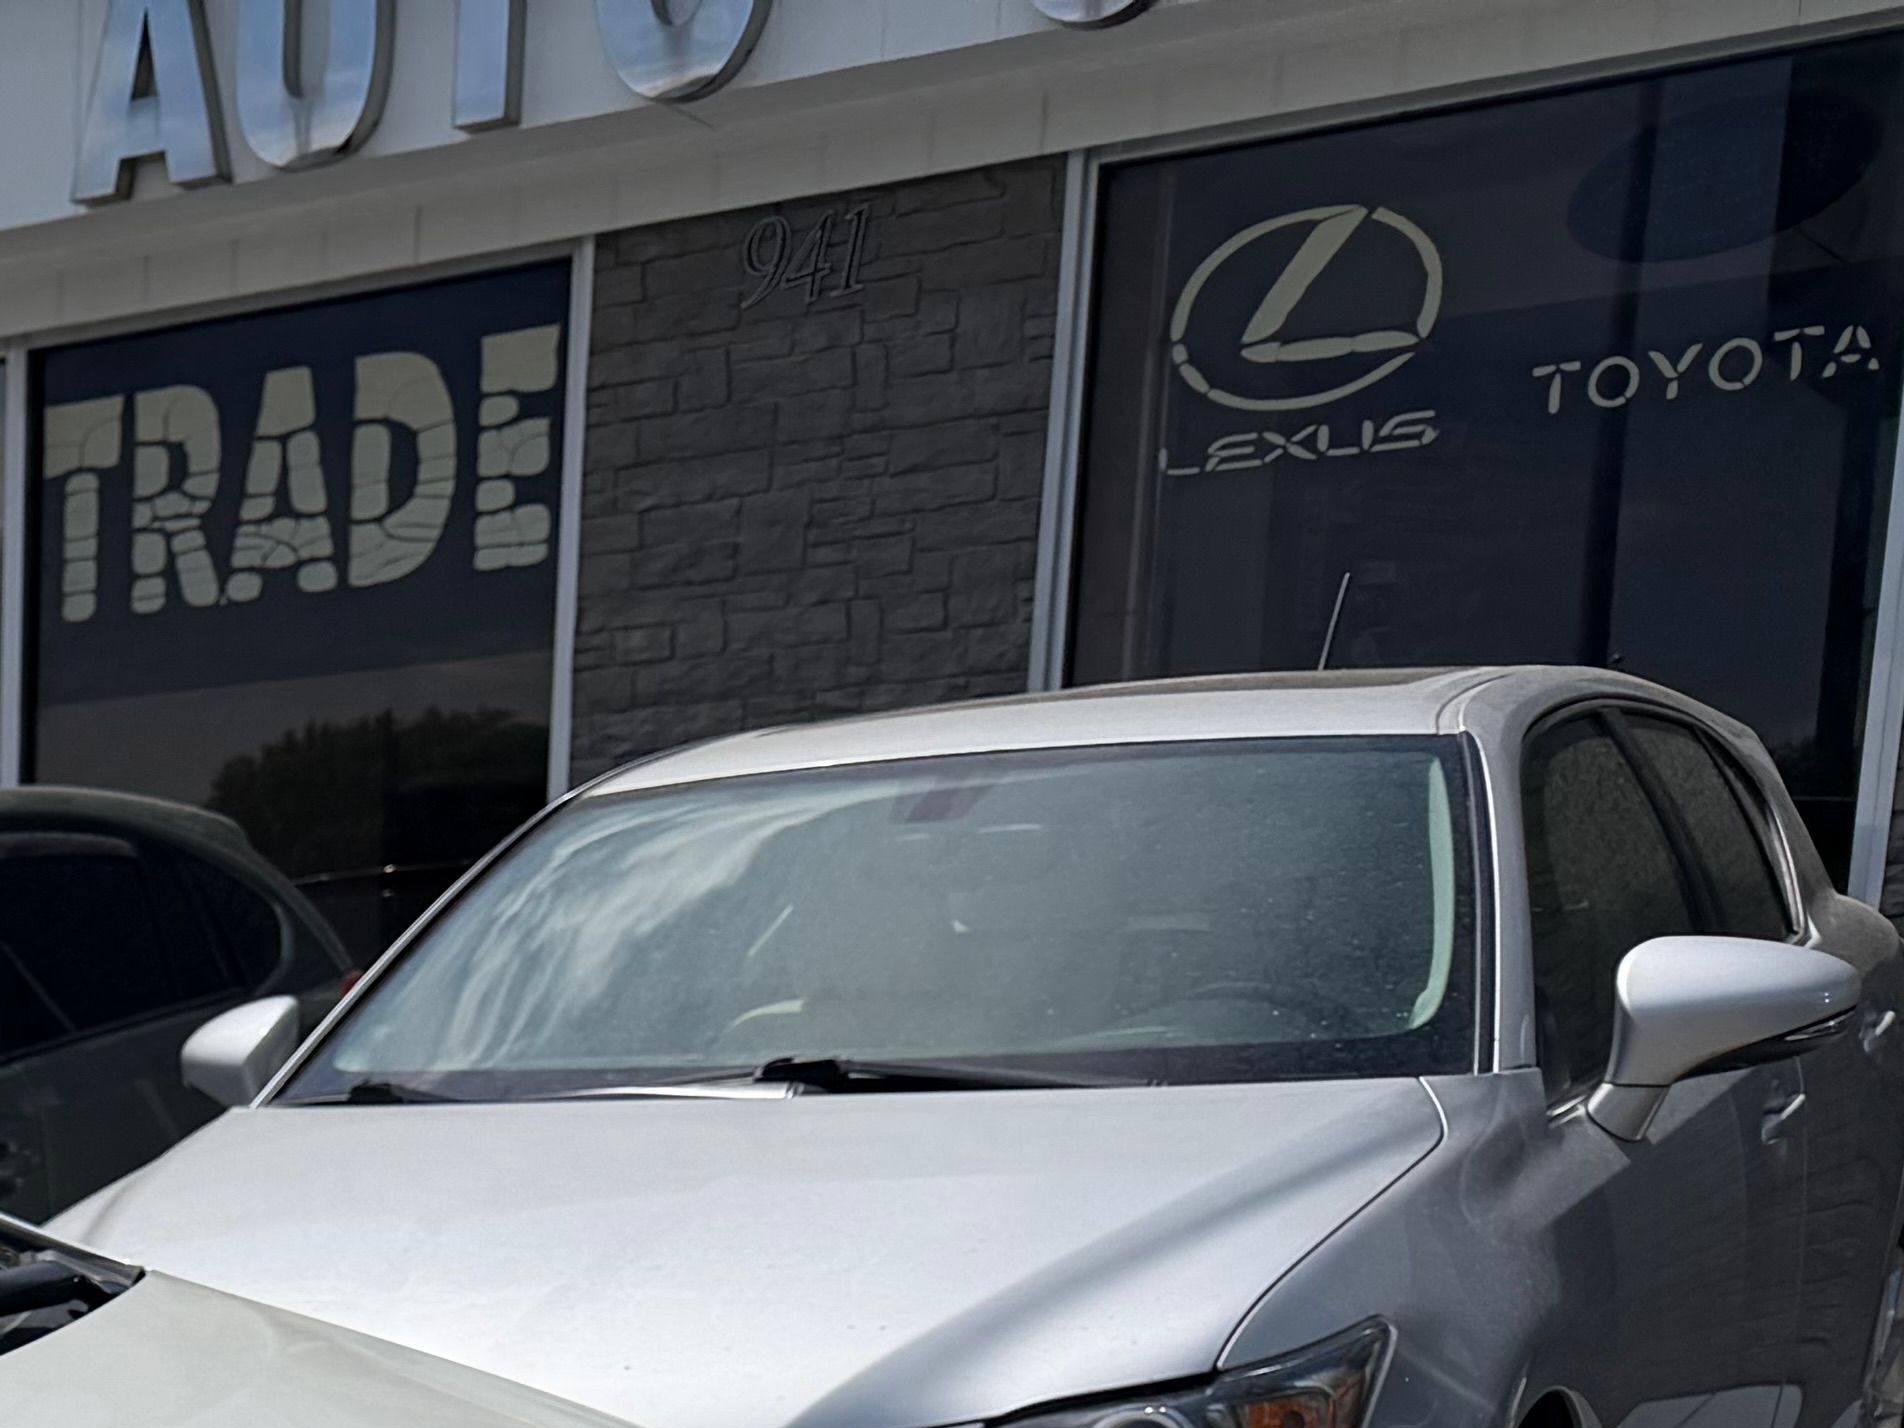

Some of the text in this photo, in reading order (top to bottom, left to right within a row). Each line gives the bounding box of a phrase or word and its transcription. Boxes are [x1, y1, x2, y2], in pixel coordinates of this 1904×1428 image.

[741, 202, 878, 309] 941
[1533, 325, 1880, 414] TOYOTA
[43, 323, 562, 623] TRADE
[1160, 410, 1438, 475] LEXUS
